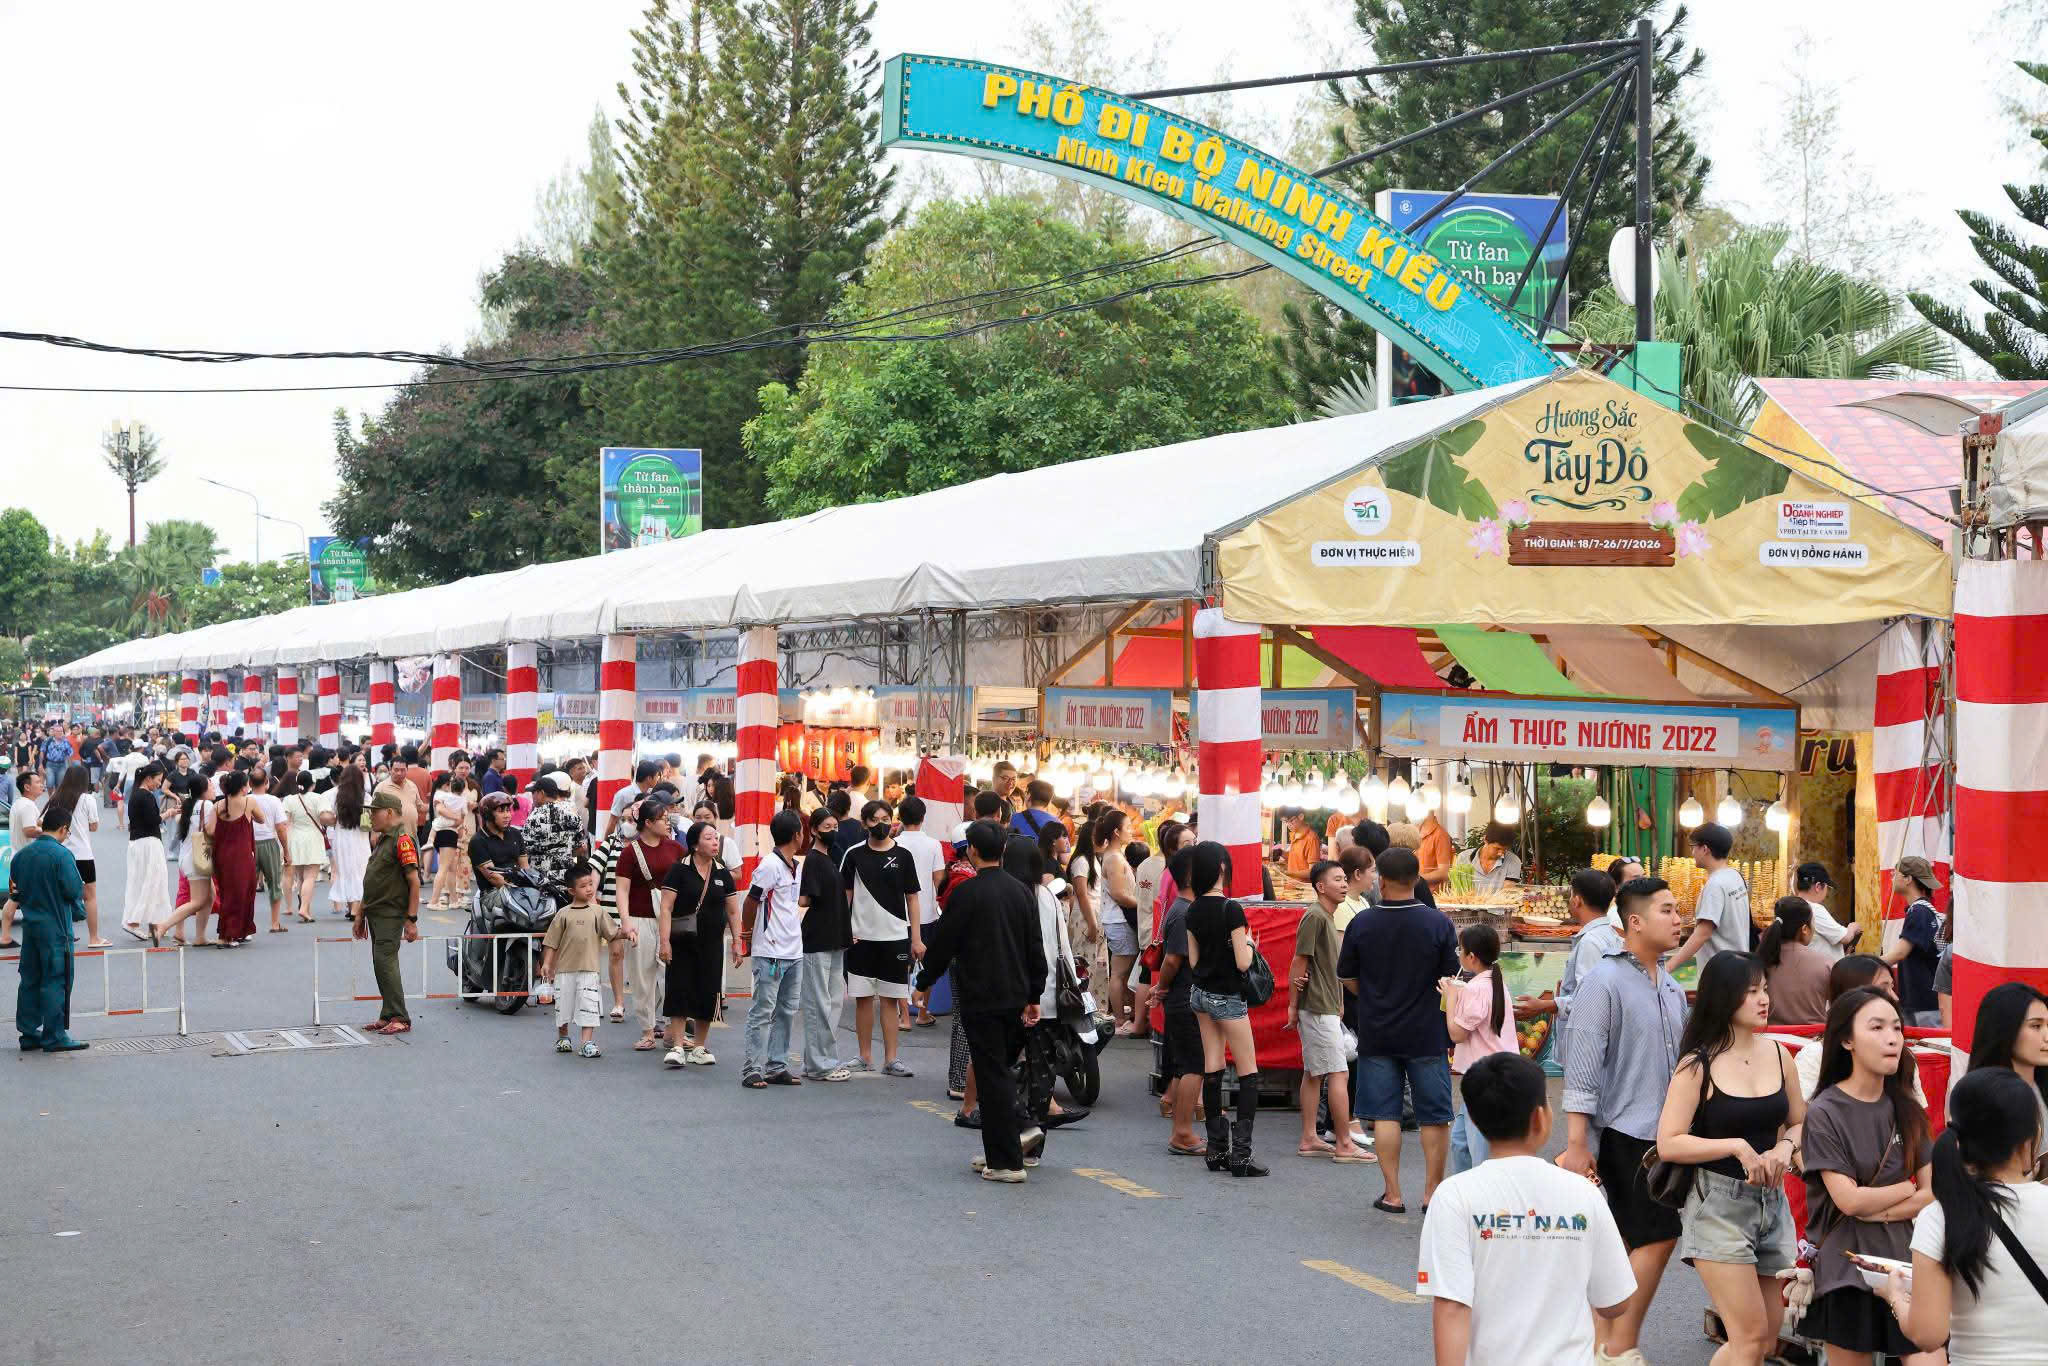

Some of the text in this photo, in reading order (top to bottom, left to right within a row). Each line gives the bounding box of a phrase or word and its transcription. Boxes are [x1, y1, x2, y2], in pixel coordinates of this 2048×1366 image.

[983, 73, 1089, 126] PHỐ
[1097, 103, 1150, 148] ĐI
[1160, 125, 1226, 182] BỘ
[1235, 158, 1353, 242] NINH
[1056, 135, 1374, 292] Ninh Kieu Walking Street
[1447, 240, 1510, 262] Từ fan
[1535, 399, 1638, 438] Hương Sắc
[651, 471, 669, 482] fan
[1524, 438, 1648, 496] Tây Đô
[623, 483, 680, 496] thành bạn
[1320, 546, 1415, 560] ĐƠN VỊ THỰC HIỆN
[1523, 535, 1662, 550] THỜI GIAN: 18/7-26/7/2026
[1768, 545, 1862, 560] ĐƠN VỊ ĐỒNG HÀNH
[1079, 705, 1097, 731] THỰC
[1126, 706, 1144, 729] 2022
[1261, 706, 1319, 735] NƯỚNG 2022
[1462, 711, 1718, 752] ẨM THỰC NƯỚNG 2022
[1535, 1213, 1588, 1231] NAM
